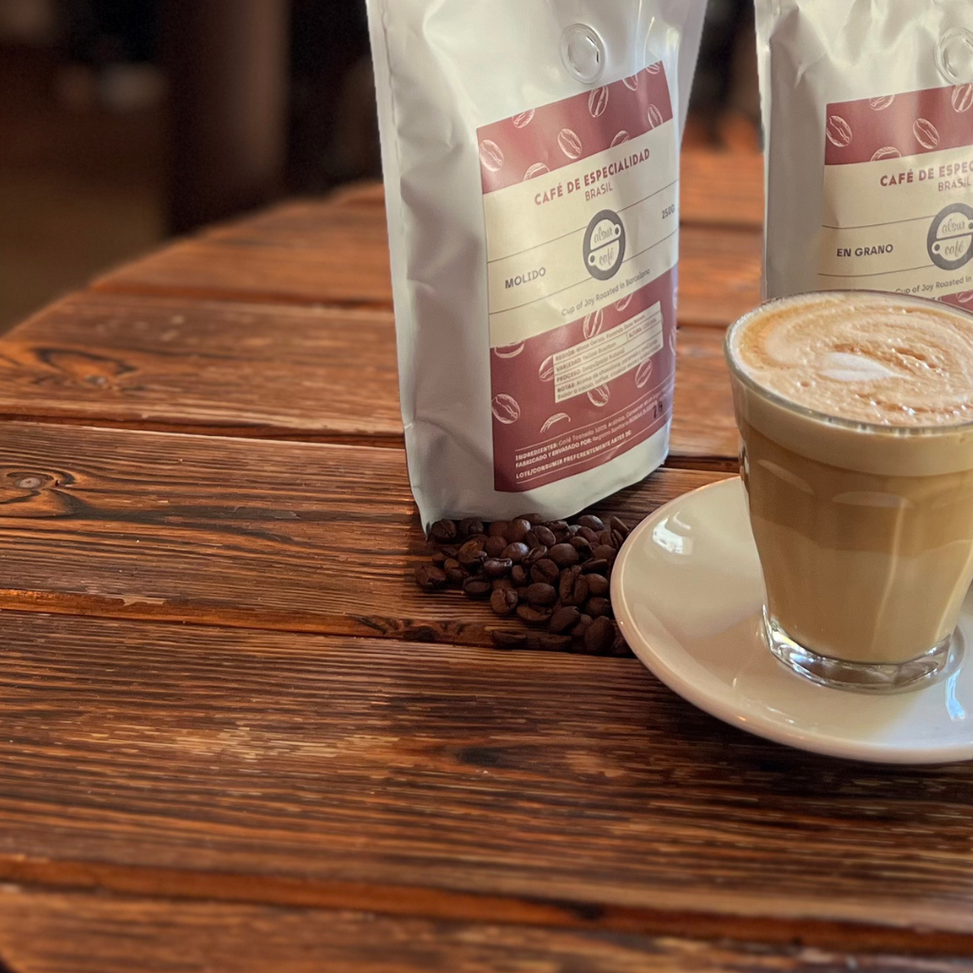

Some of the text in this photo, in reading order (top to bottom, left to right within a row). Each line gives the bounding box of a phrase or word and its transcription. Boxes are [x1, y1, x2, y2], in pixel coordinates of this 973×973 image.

[534, 148, 650, 206] CAFÉ DE ESPECIALIDAD
[880, 168, 914, 187] CAFÉ
[918, 167, 935, 182] DE
[938, 178, 972, 192] BRASIL
[585, 184, 613, 202] BRASIL
[836, 243, 894, 258] EN GRANO
[505, 267, 546, 289] MOLIDO
[912, 283, 920, 293] of
[921, 283, 934, 293] Joy
[935, 276, 964, 289] Roasted
[561, 305, 576, 317] Cup
[576, 300, 583, 310] of
[584, 296, 595, 309] Joy
[595, 285, 619, 301] Roasted
[625, 268, 651, 287] Barcelona
[515, 458, 563, 480] LOTE/CONSUMIR
[563, 440, 611, 463] PREFERENTEMENTE
[515, 453, 547, 468] FABRICADO
